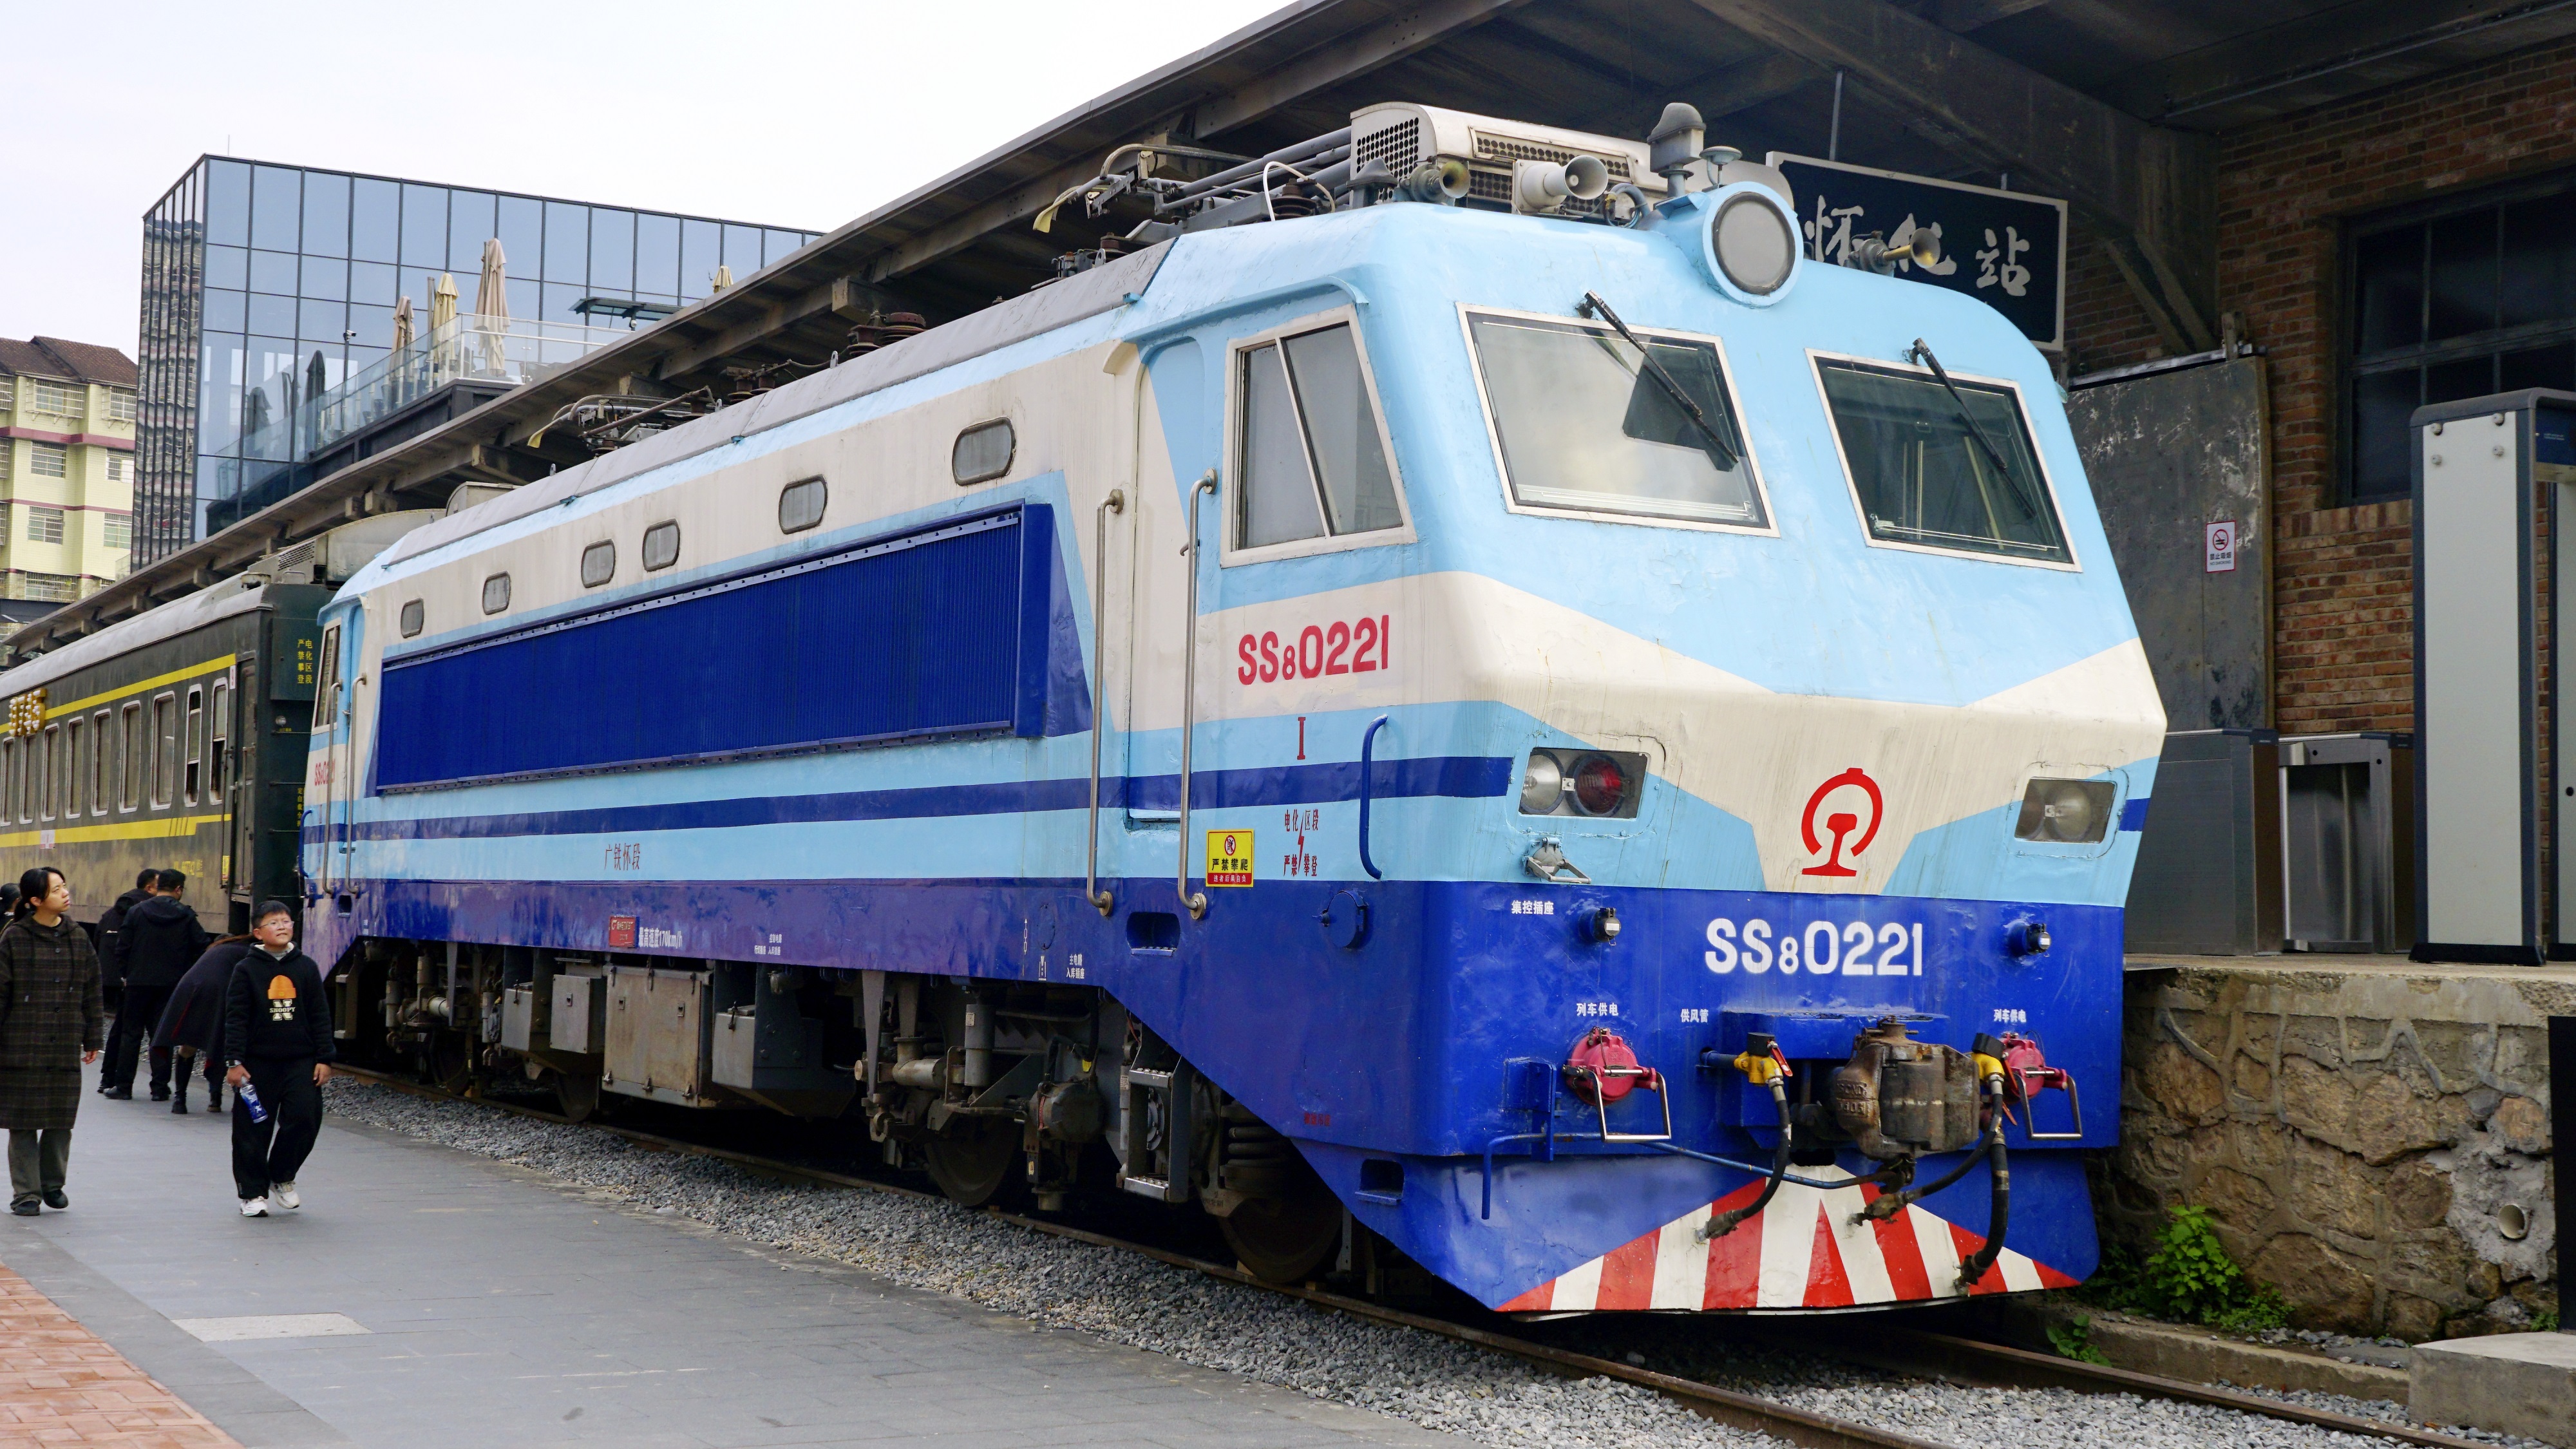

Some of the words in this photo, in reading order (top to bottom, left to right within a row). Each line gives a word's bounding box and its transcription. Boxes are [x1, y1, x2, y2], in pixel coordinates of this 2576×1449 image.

[2210, 552, 2232, 560] 禁止吸烟
[604, 842, 641, 871] 广铁怀段
[1211, 858, 1248, 871] 严禁攀爬
[1213, 875, 1246, 883] 违者后果自负
[1511, 900, 1554, 915] 集控插座
[1066, 967, 1084, 979] 入库插座
[1576, 1003, 1619, 1017] 列车供电
[1680, 1009, 1709, 1023] 供风管
[1993, 1009, 2027, 1023] 列车供电
